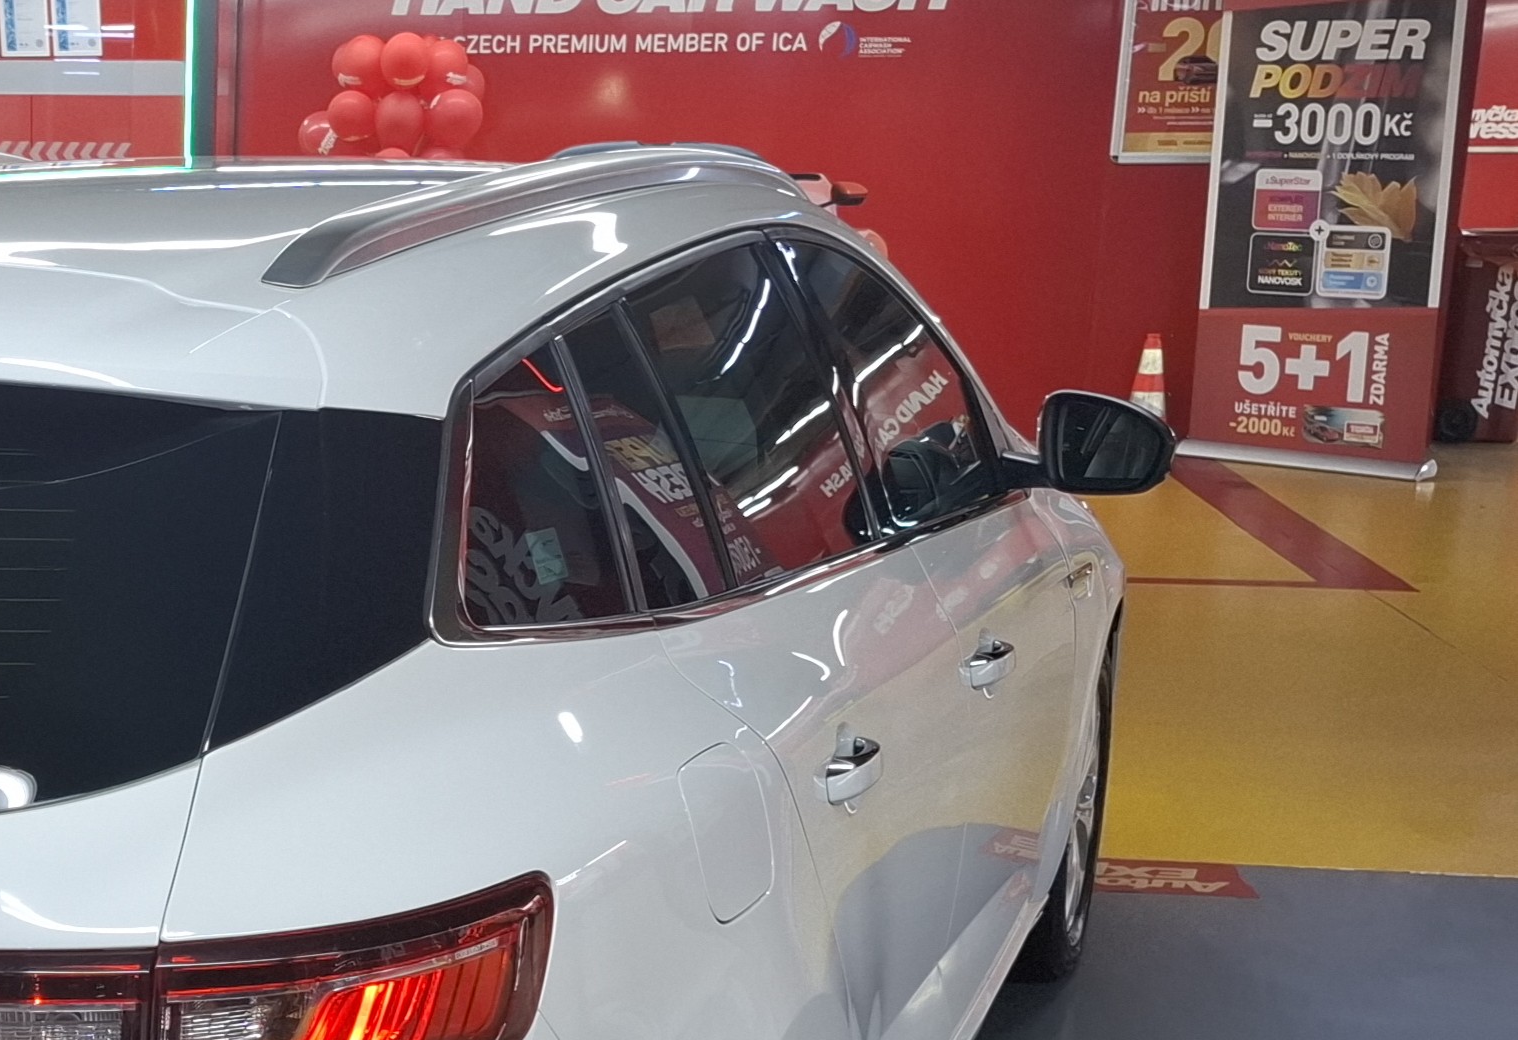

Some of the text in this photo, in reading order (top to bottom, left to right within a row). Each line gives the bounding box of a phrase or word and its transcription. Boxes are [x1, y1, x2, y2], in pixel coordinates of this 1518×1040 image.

[529, 33, 627, 54] PREMIUM
[635, 32, 728, 53] MEMBER
[736, 32, 765, 52] OF
[772, 32, 808, 52] ICA
[1256, 18, 1432, 62] SUPER
[1249, 63, 1426, 99] PODZIM
[1138, 86, 1213, 107] na příští
[1252, 102, 1414, 146] -3000 Kč
[1257, 275, 1303, 286] NANOVOSK
[1368, 332, 1391, 406] ZDARMA
[1234, 399, 1297, 419] UŠETŘÍTE
[1229, 416, 1282, 437] -2000
